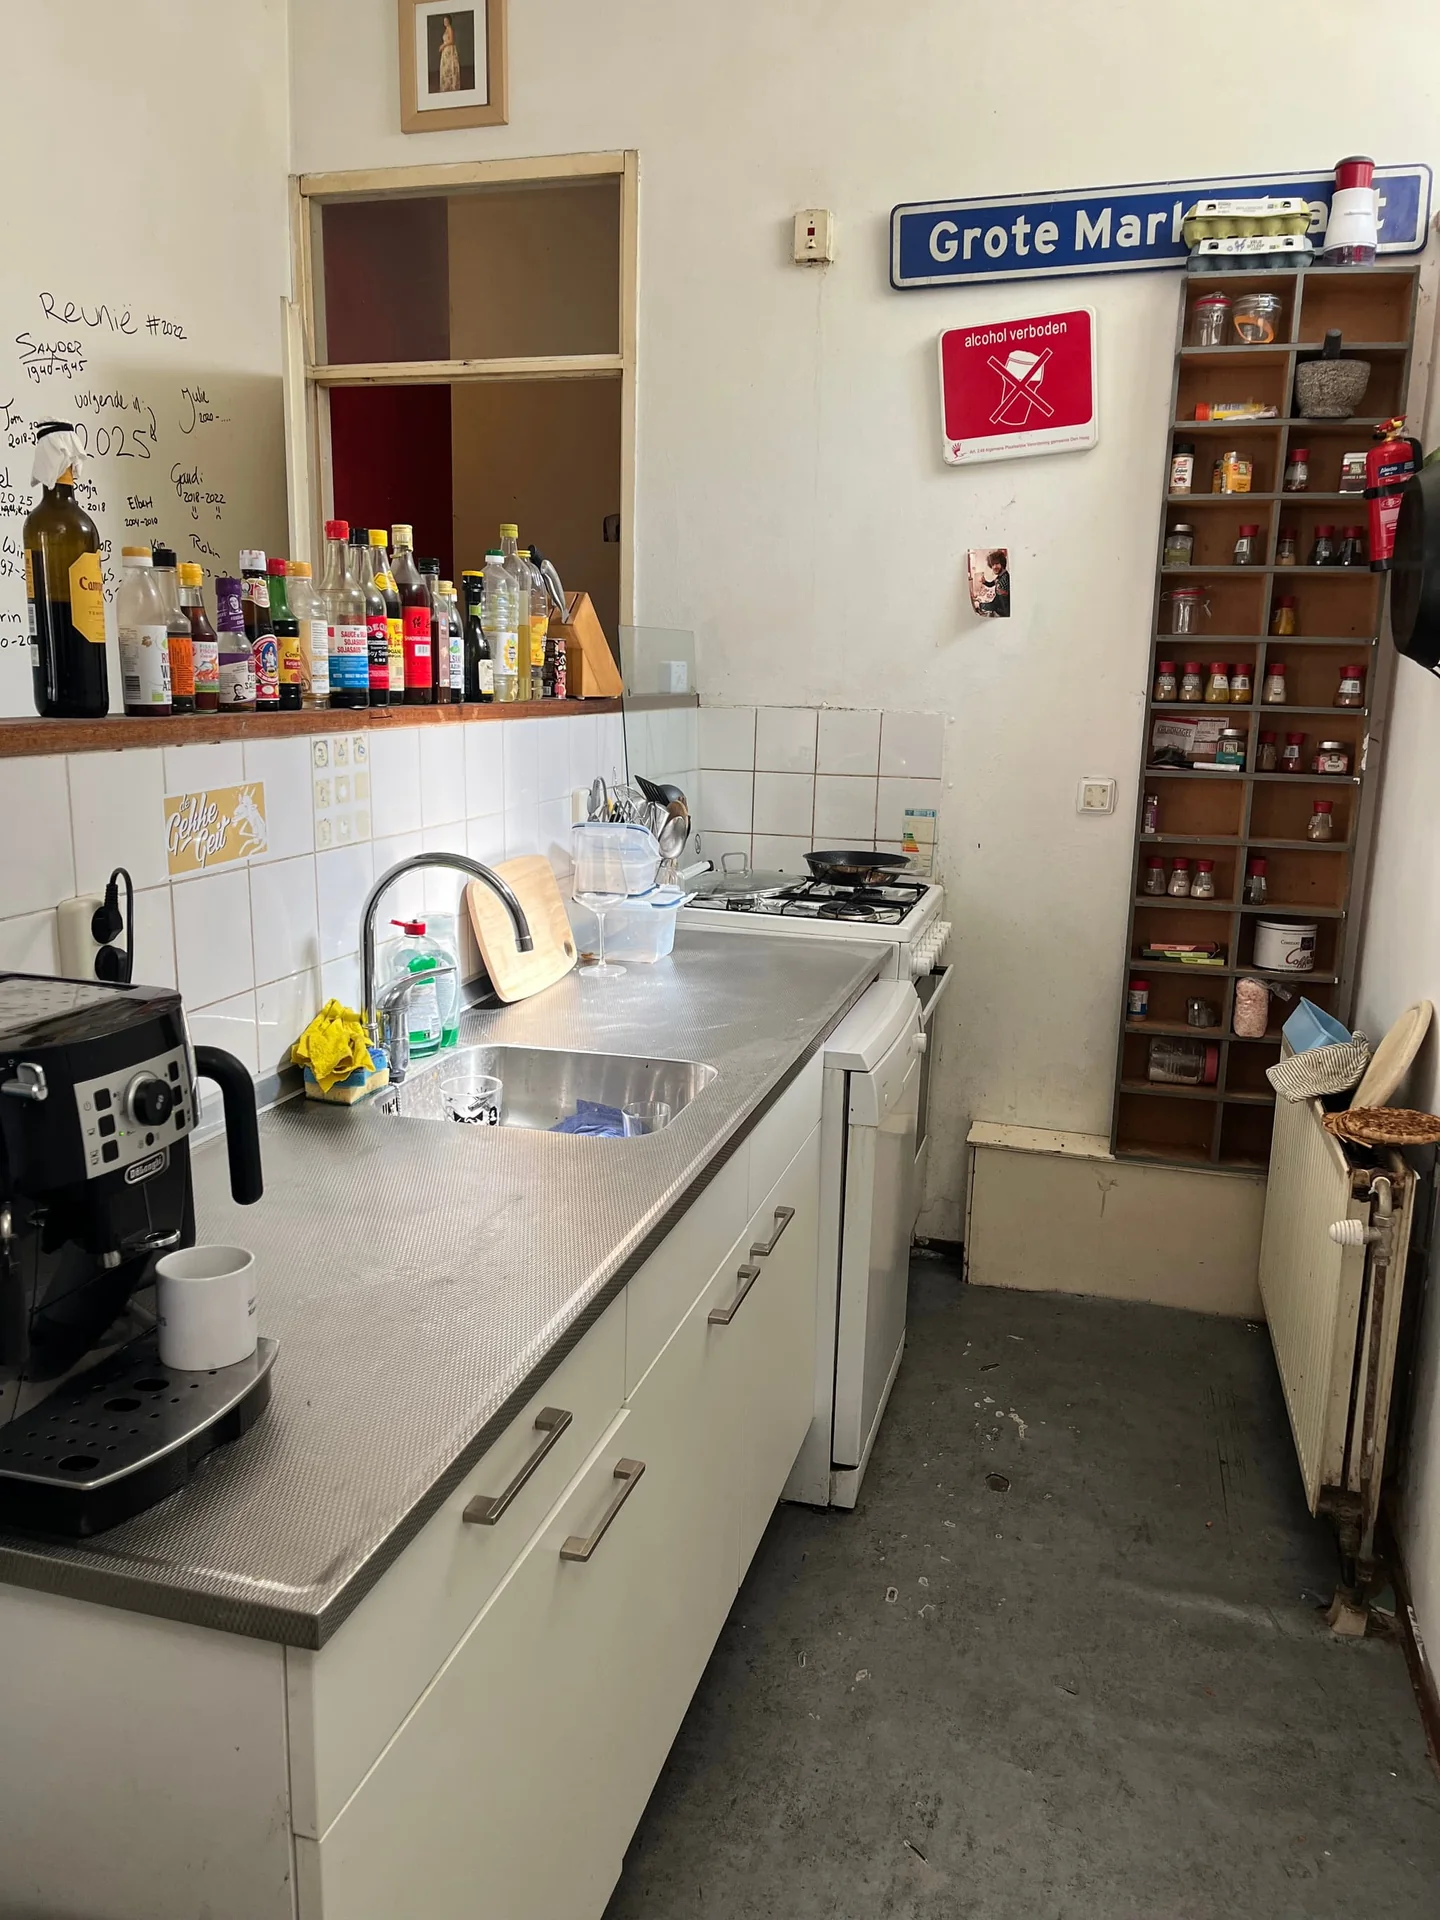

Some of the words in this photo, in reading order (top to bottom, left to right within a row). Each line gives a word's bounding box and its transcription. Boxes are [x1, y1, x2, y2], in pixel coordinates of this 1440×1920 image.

[928, 214, 1060, 263] Grote
[145, 314, 188, 340] #2022
[964, 327, 1007, 348] alcohol
[1009, 321, 1067, 340] verboden
[74, 390, 128, 414] volgende
[75, 422, 151, 459] 2025
[183, 491, 226, 504] 2018-2022
[189, 533, 221, 558] Robin
[179, 794, 190, 811] de
